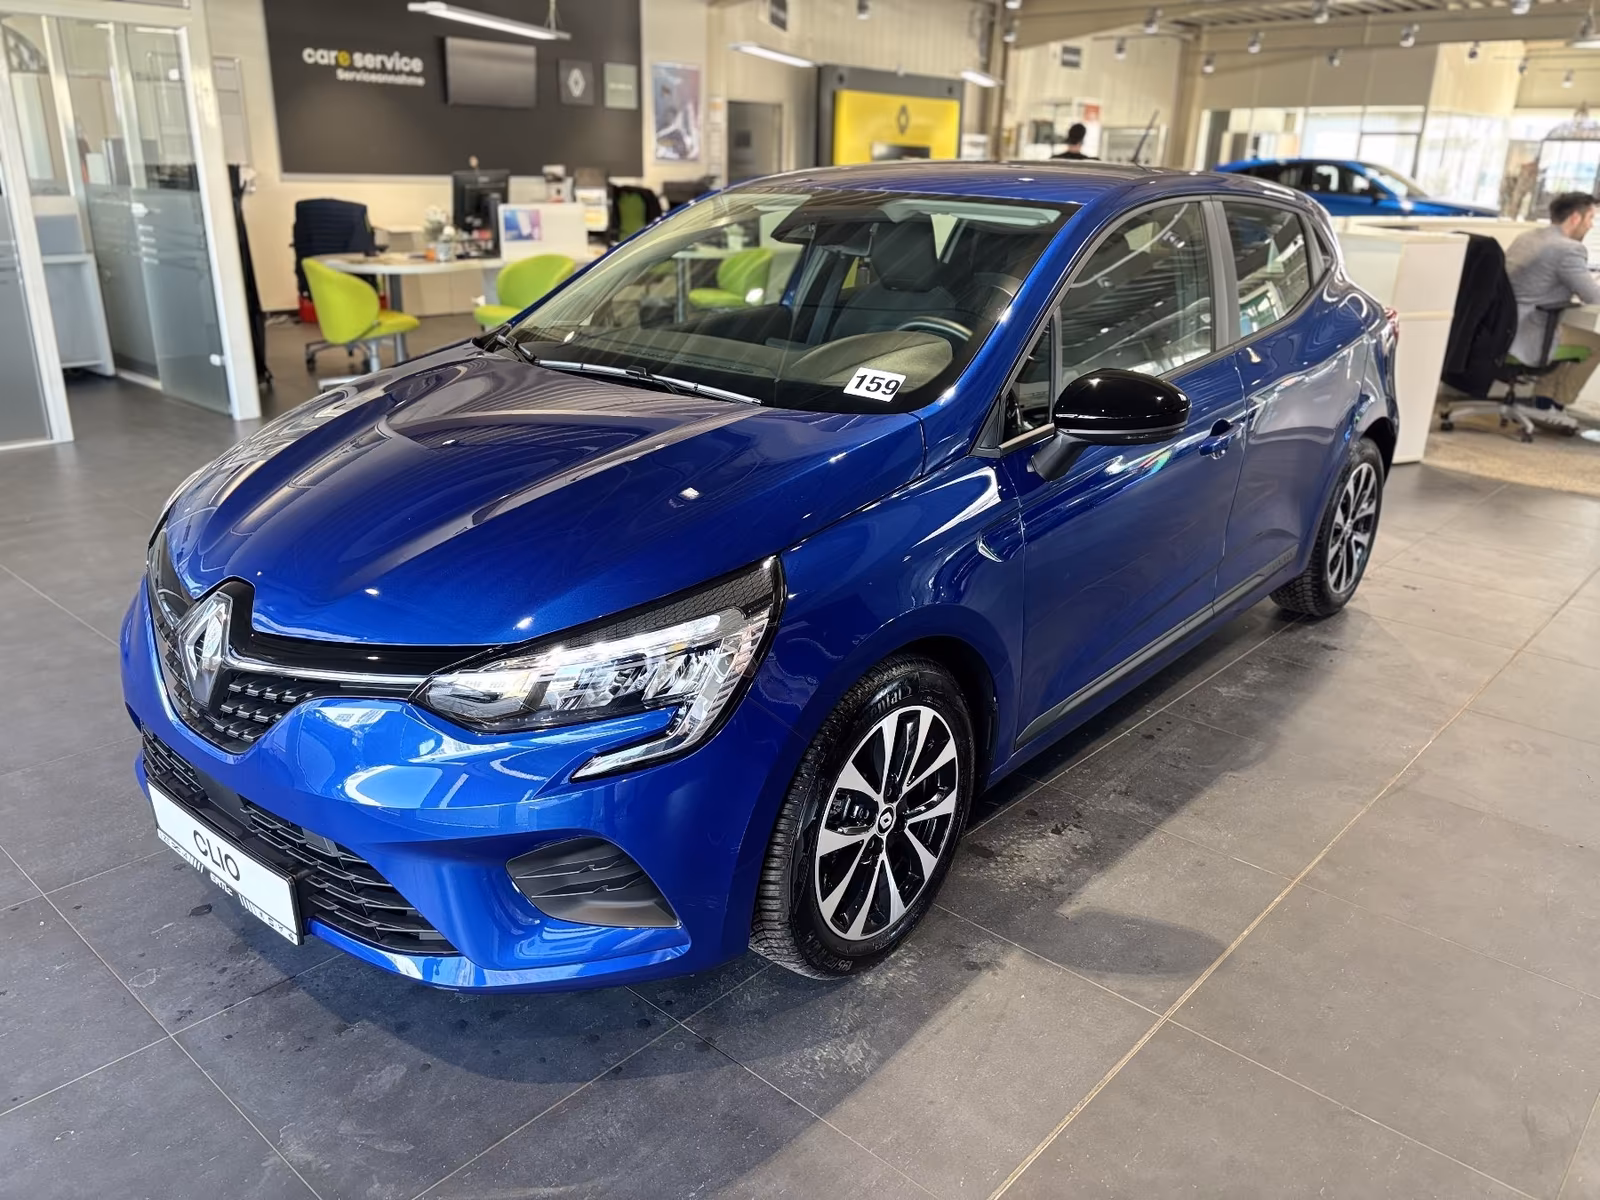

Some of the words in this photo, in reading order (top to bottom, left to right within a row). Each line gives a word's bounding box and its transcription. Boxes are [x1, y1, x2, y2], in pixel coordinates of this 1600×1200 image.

[302, 47, 351, 67] care
[352, 51, 424, 73] service
[854, 374, 901, 396] 159
[193, 829, 241, 882] CLIO
